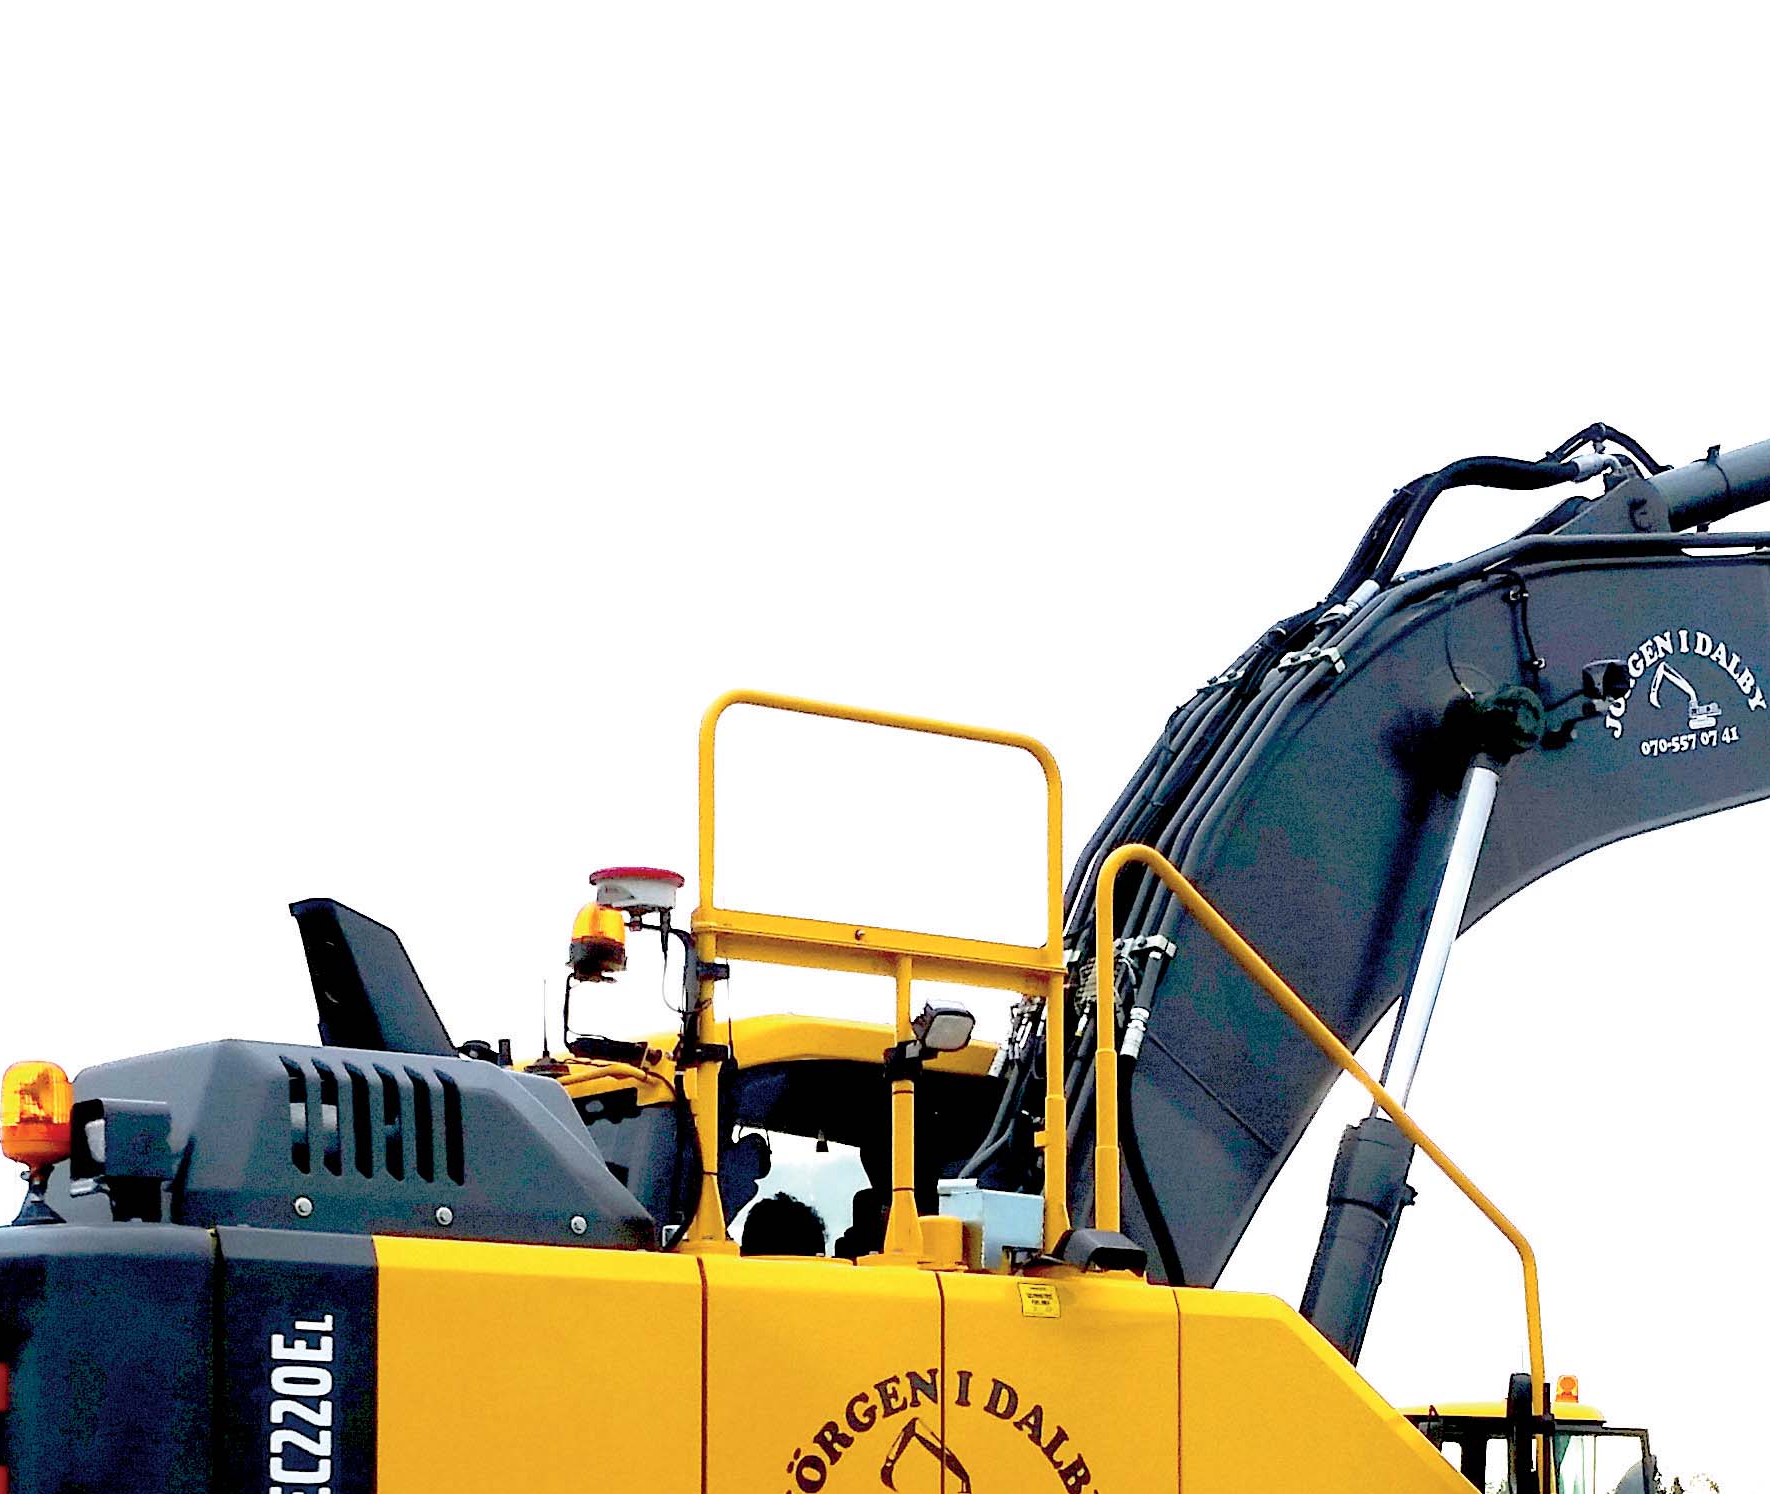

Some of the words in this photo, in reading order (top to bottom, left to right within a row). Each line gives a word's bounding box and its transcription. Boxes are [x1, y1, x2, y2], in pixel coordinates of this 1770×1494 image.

[1605, 631, 1674, 739] JGEN
[1678, 629, 1690, 653] I
[1694, 631, 1768, 712] DALBY
[1641, 733, 1697, 757] 070-557
[1700, 730, 1718, 747] 07
[1721, 726, 1740, 744] 41
[956, 1370, 973, 1407] I
